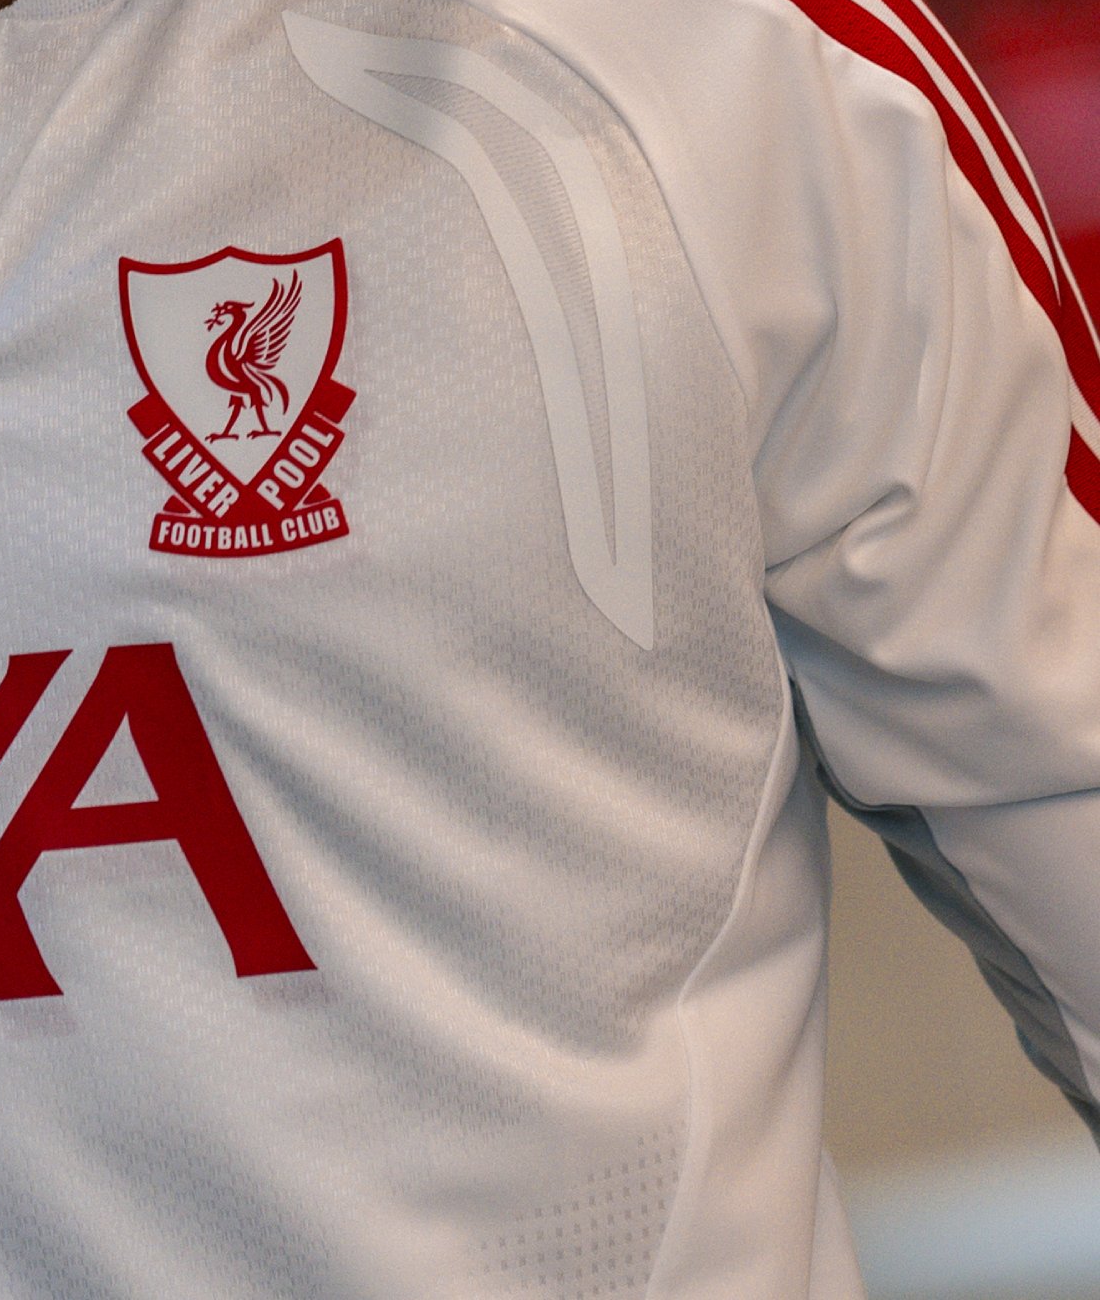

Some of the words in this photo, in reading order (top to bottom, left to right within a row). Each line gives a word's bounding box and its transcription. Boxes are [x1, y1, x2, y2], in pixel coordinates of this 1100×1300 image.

[152, 430, 240, 518] LIVER
[256, 424, 335, 510] POOL
[157, 520, 274, 550] FOOTBALL
[281, 506, 341, 542] CLUB
